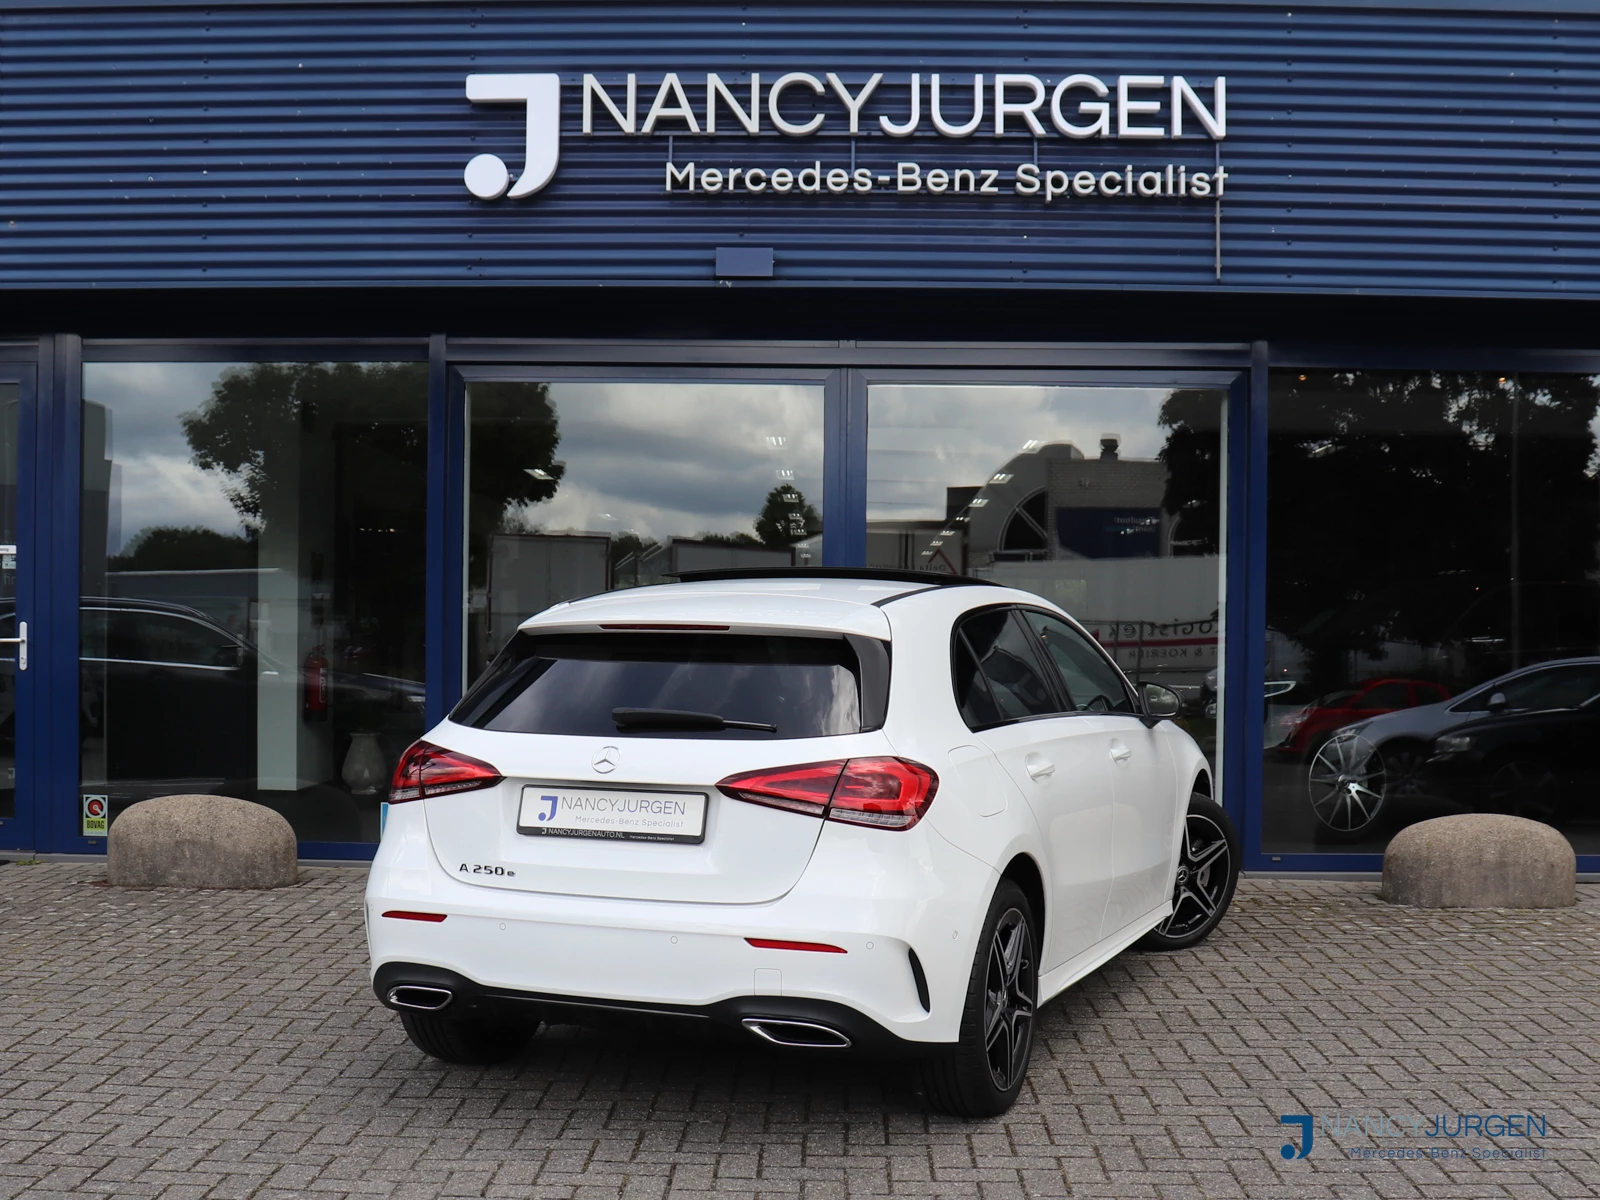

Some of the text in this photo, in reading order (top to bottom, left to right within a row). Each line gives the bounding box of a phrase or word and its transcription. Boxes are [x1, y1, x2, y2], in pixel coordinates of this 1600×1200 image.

[582, 72, 1227, 140] NANCYJURGEN
[665, 160, 1229, 203] Mercedes-Benz Specialist
[561, 796, 686, 816] NANCYJURGEN
[86, 820, 105, 829] BOVAG
[575, 815, 684, 828] Mercedes-Benz Specialist
[548, 828, 625, 839] NANCYJURGENAUTO.NL
[459, 863, 469, 873] A
